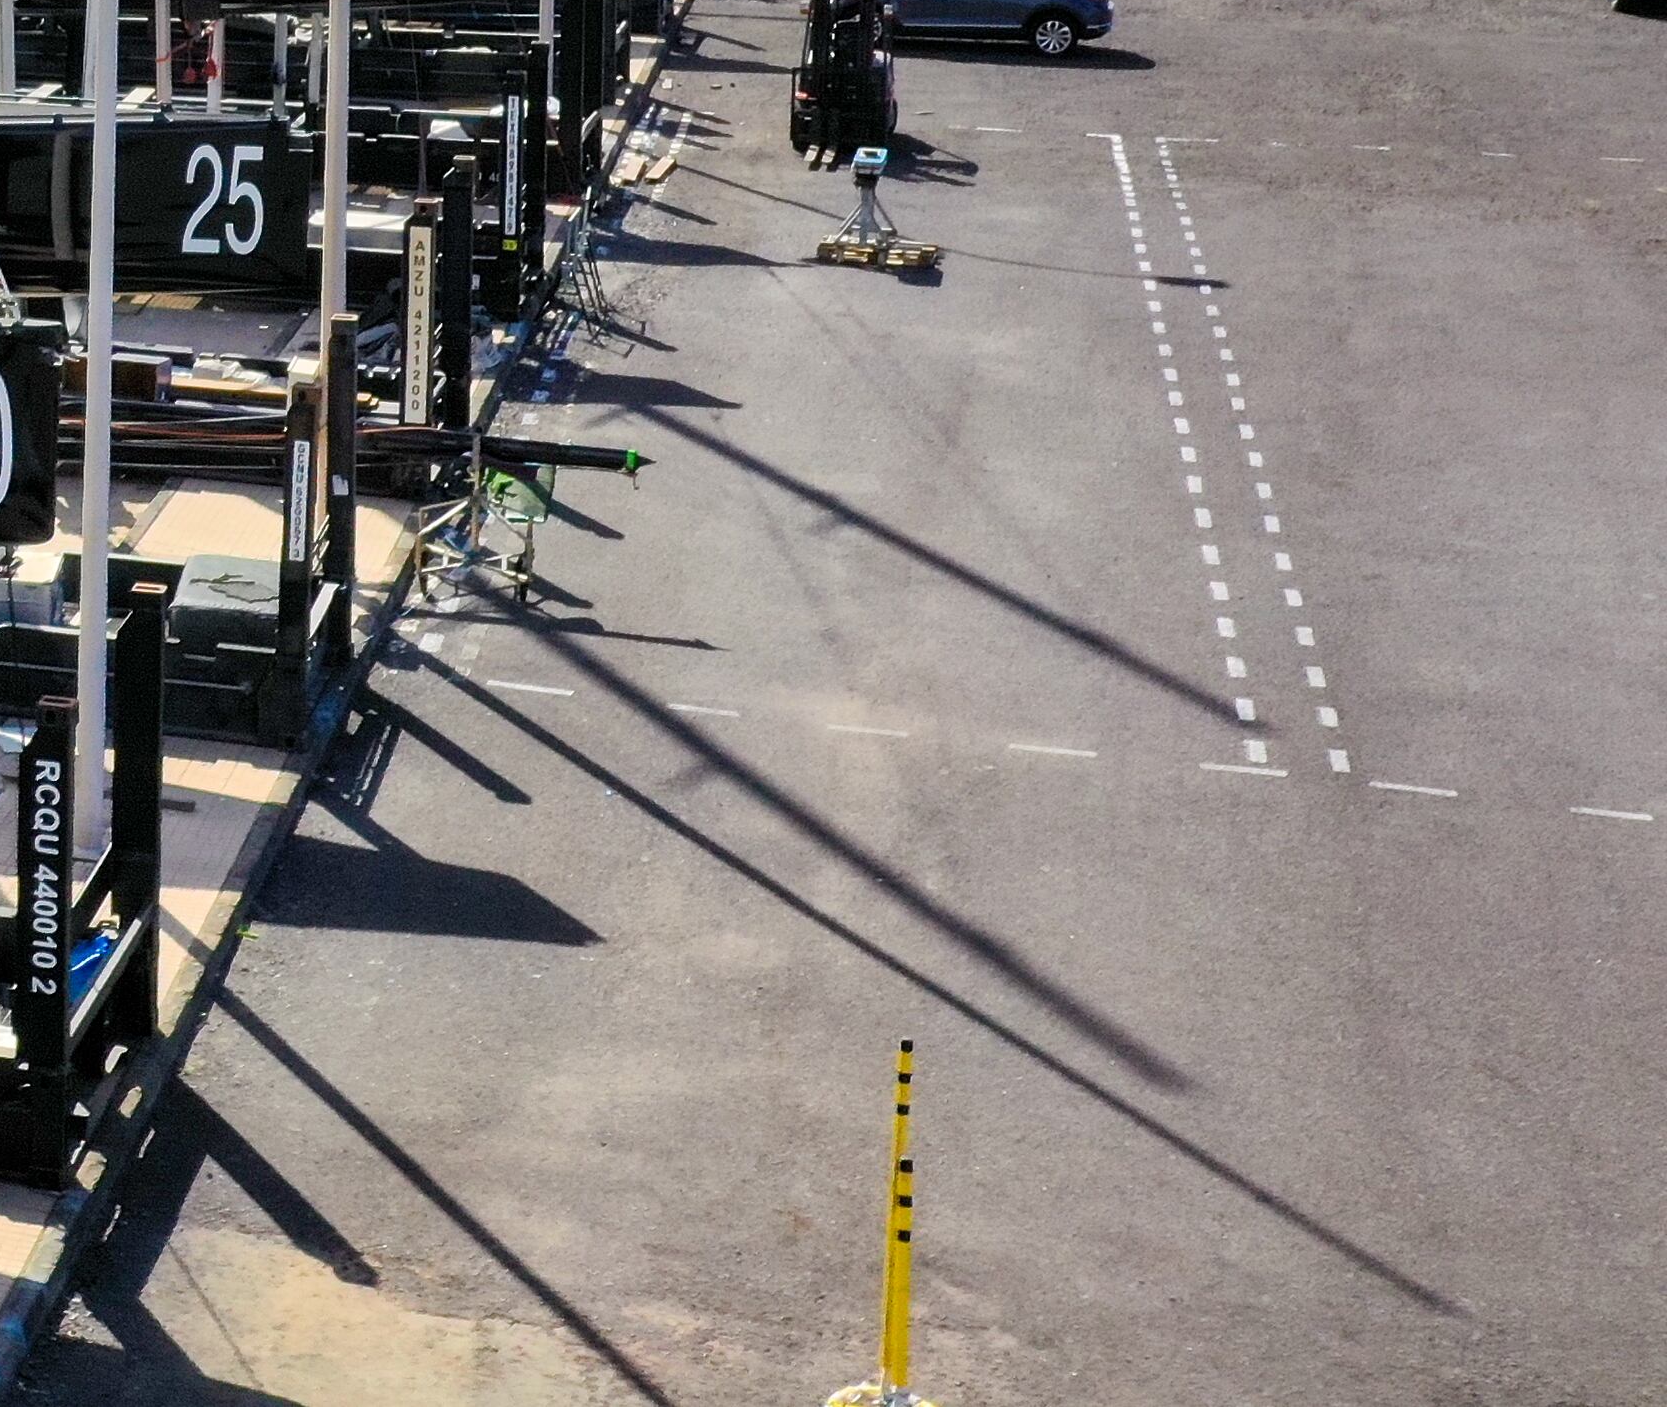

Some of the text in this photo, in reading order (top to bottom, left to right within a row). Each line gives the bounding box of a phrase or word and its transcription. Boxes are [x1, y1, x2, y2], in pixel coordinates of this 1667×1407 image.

[181, 144, 265, 256] 25
[412, 240, 426, 411] AMZU 4211200
[31, 759, 61, 995] RCQU 440010 2
